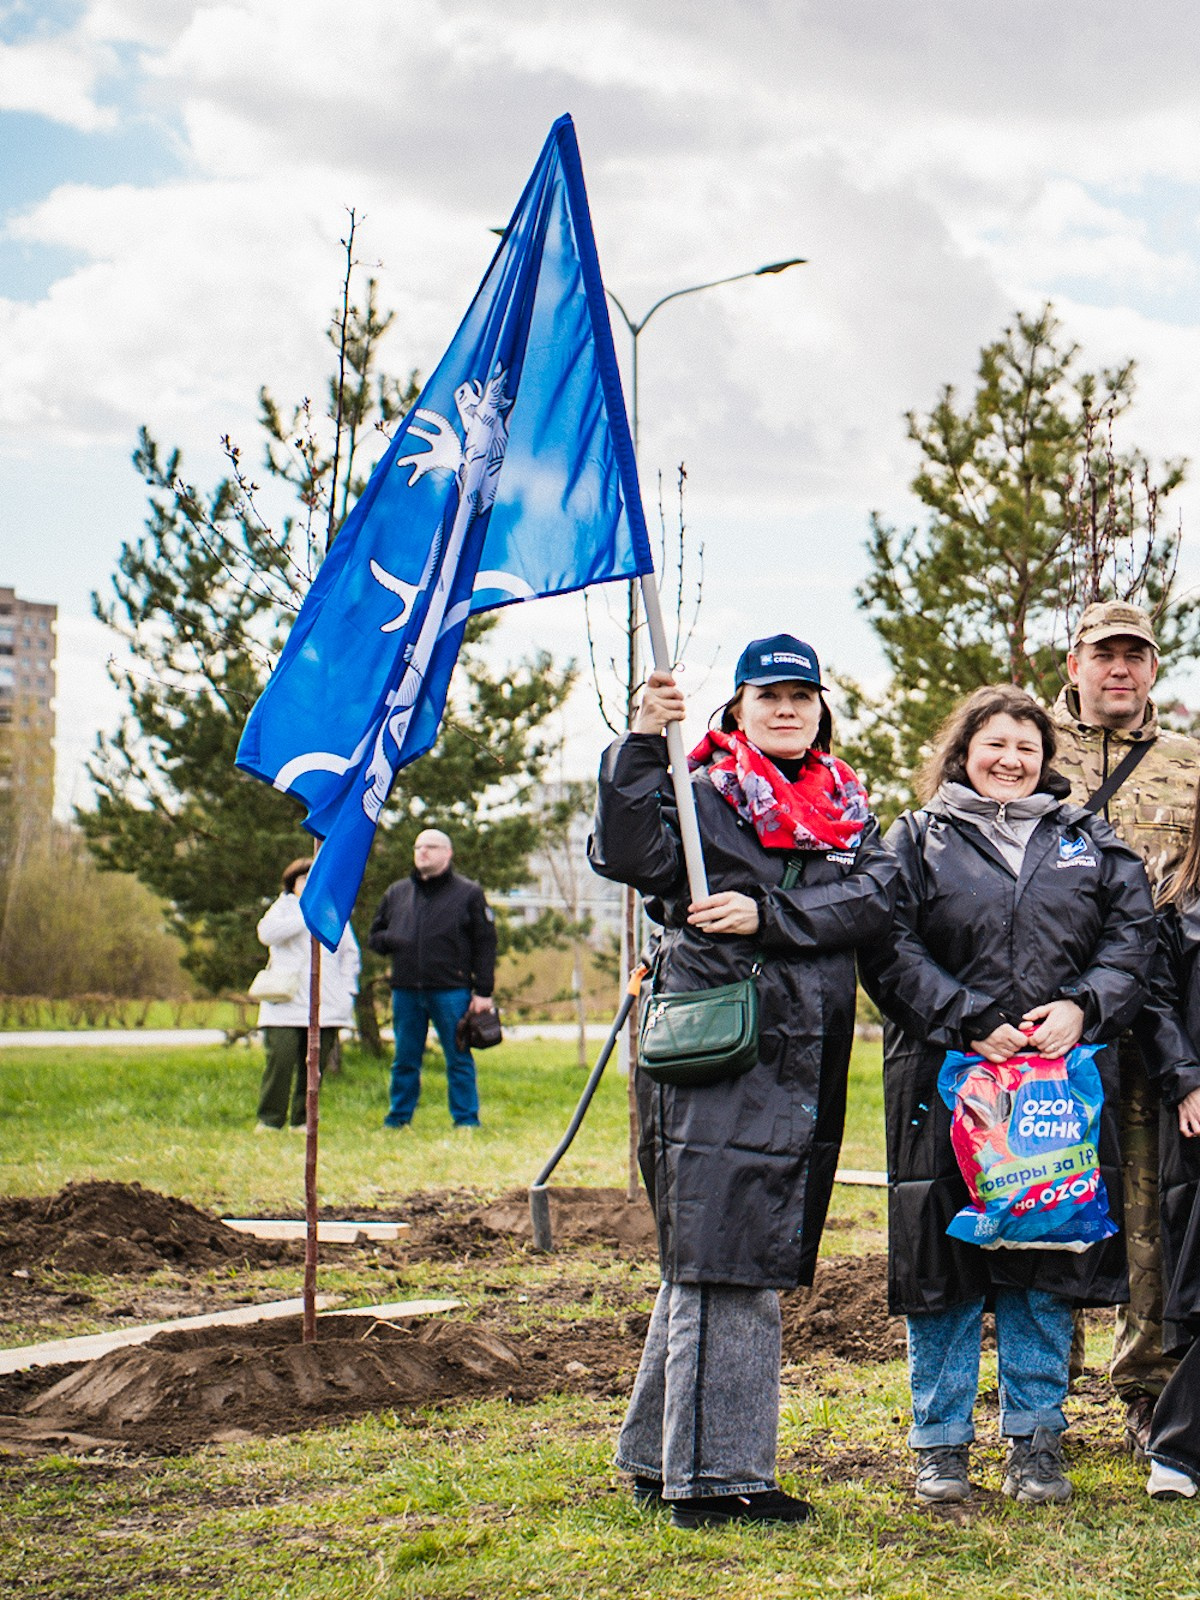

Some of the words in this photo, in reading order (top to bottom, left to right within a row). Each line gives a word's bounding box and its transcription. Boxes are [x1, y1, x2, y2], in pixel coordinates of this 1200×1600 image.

[1018, 1116, 1082, 1140] банк
[1052, 1158, 1075, 1174] за
[1014, 1198, 1036, 1211] на
